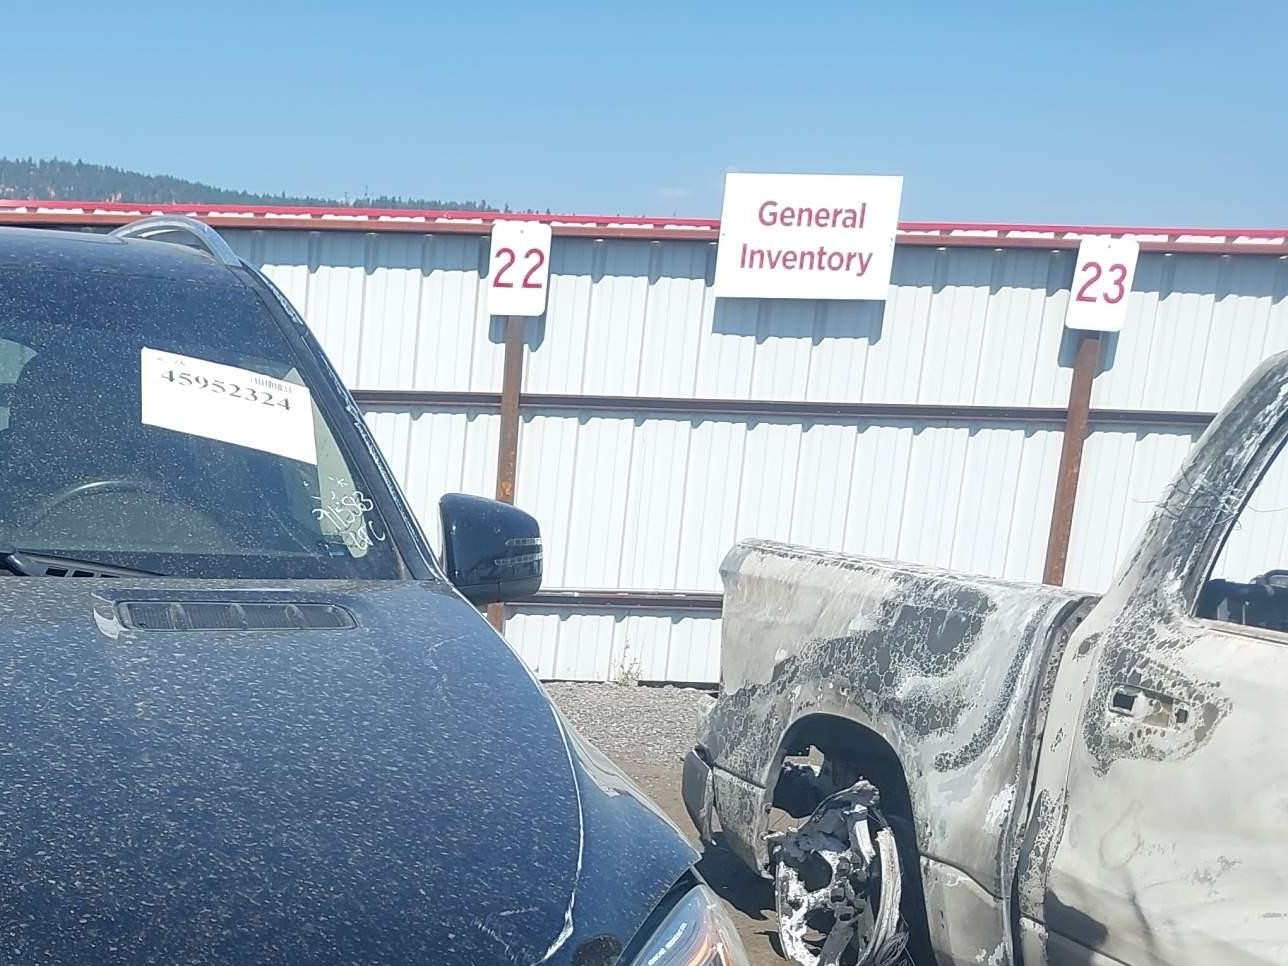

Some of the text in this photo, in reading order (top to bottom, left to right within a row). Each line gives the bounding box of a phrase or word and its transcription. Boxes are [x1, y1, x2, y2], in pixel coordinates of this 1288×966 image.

[758, 200, 867, 229] General
[492, 246, 545, 289] 22
[739, 243, 873, 277] Inventory
[1076, 261, 1128, 305] 23
[160, 369, 292, 411] 45952324
